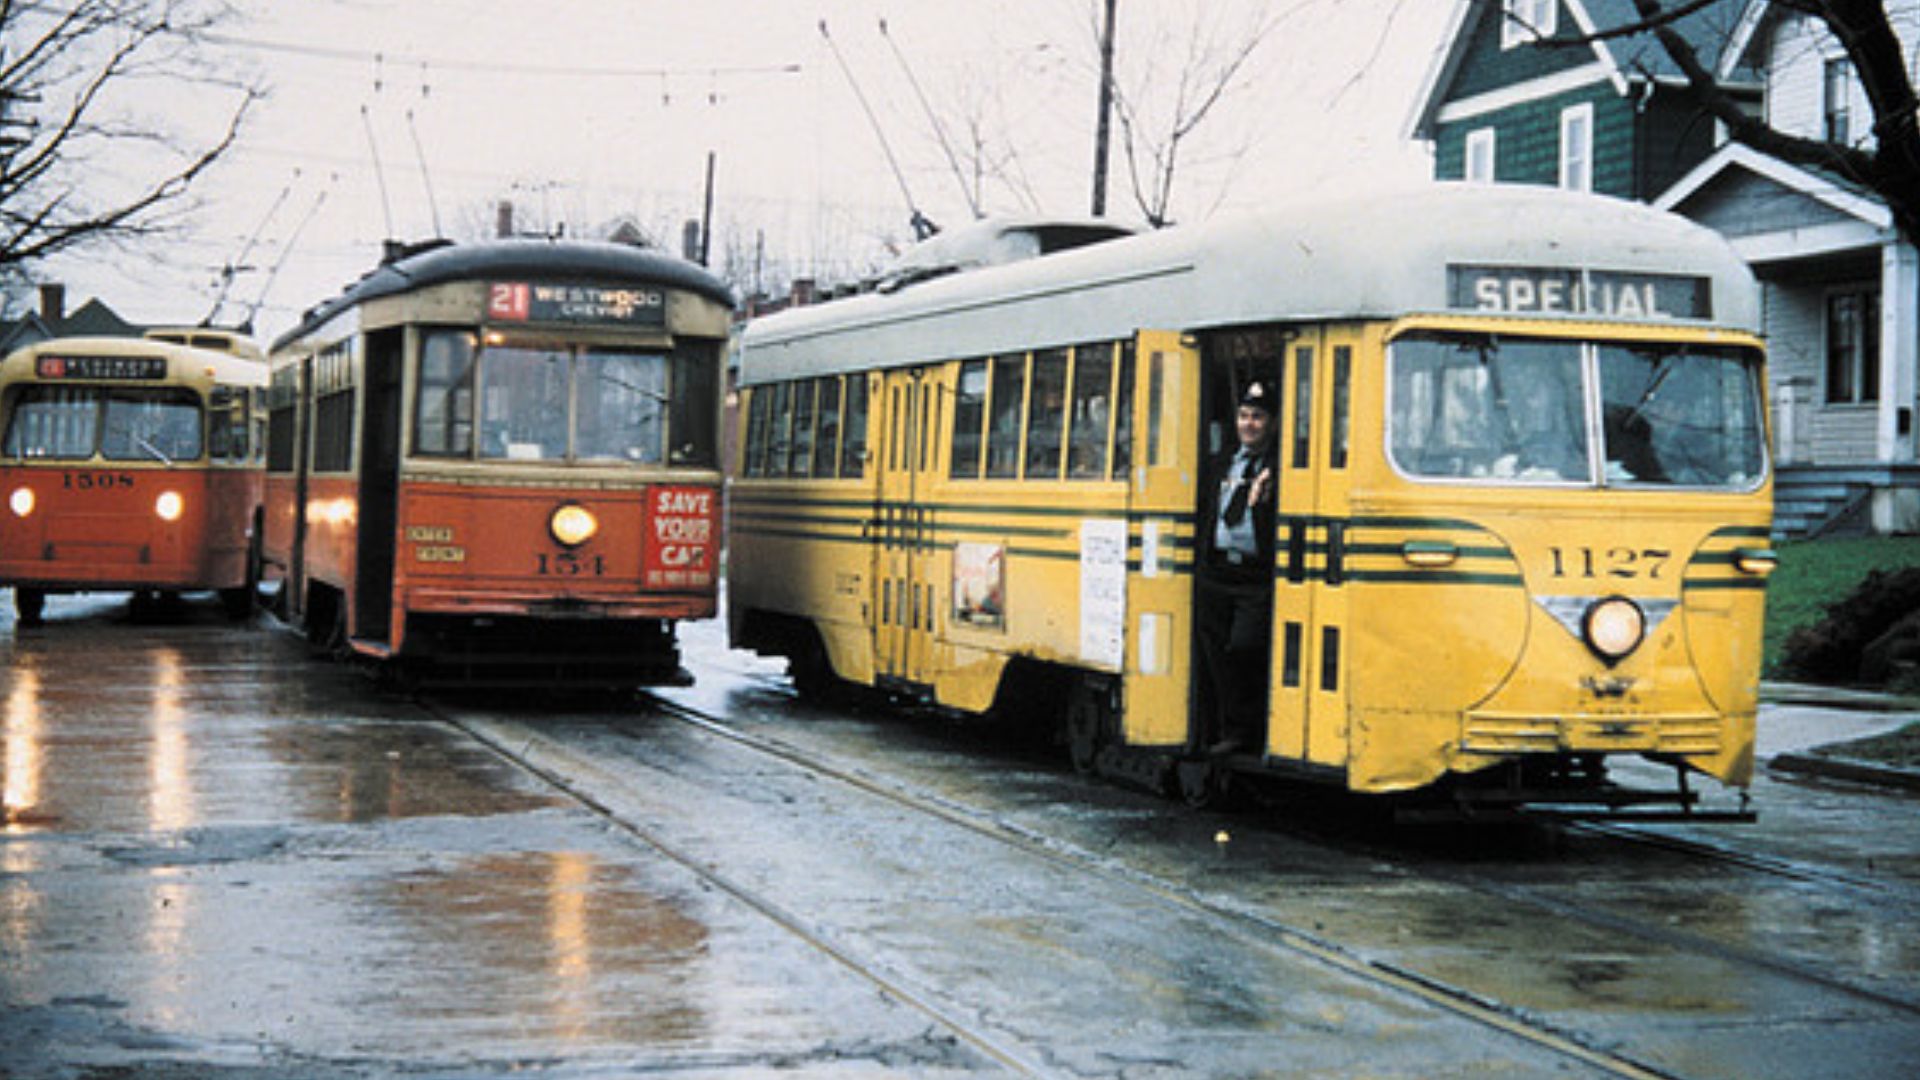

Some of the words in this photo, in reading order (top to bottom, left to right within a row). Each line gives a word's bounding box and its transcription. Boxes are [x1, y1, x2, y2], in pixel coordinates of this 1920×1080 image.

[491, 283, 525, 312] 21
[535, 286, 663, 307] WESTWOOD
[1475, 276, 1672, 320] SPECIAL
[657, 491, 710, 514] SAVE
[654, 516, 710, 543] YOUR
[1548, 547, 1671, 579] 1127
